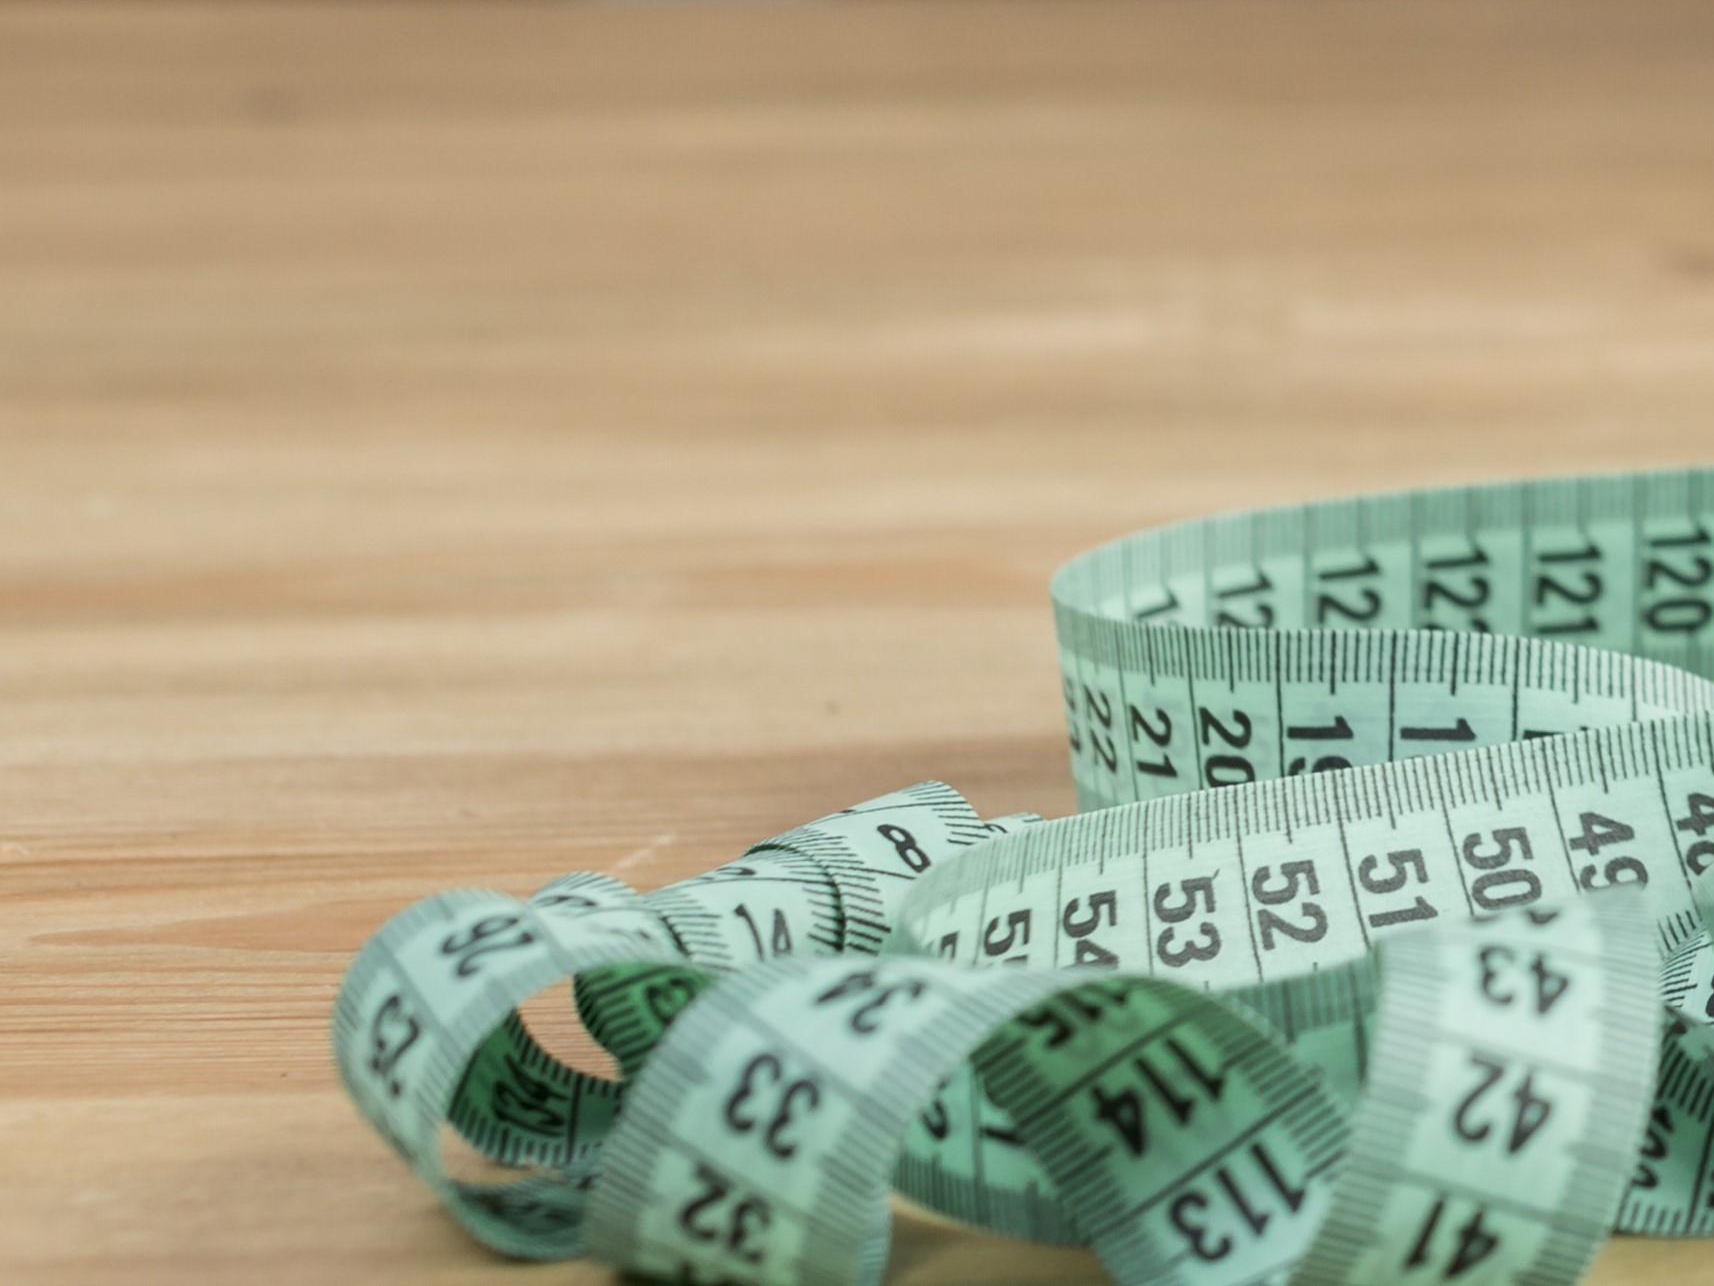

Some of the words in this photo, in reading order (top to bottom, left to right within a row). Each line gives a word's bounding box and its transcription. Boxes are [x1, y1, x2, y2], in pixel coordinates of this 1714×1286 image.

[1216, 563, 1275, 628] 12
[1317, 555, 1383, 626] 12
[1424, 544, 1492, 634] 12
[1536, 543, 1603, 635] 121
[1644, 523, 1713, 636] 120
[1083, 683, 1118, 774] 22
[1129, 704, 1179, 780] 21
[1198, 706, 1256, 788] 20
[1358, 848, 1438, 928] 51
[1462, 827, 1542, 910] 50
[1570, 811, 1648, 891] 49
[983, 908, 1031, 965] 5
[1062, 890, 1118, 969] 54
[1153, 877, 1220, 968] 53
[1251, 859, 1328, 950] 52
[1478, 943, 1569, 1016] 43
[724, 1054, 820, 1159] 33
[1093, 1037, 1223, 1157] 114
[1450, 1054, 1553, 1155] 42
[678, 1160, 770, 1264] 32
[1169, 1141, 1305, 1262] 113
[1404, 1196, 1500, 1280] 41
